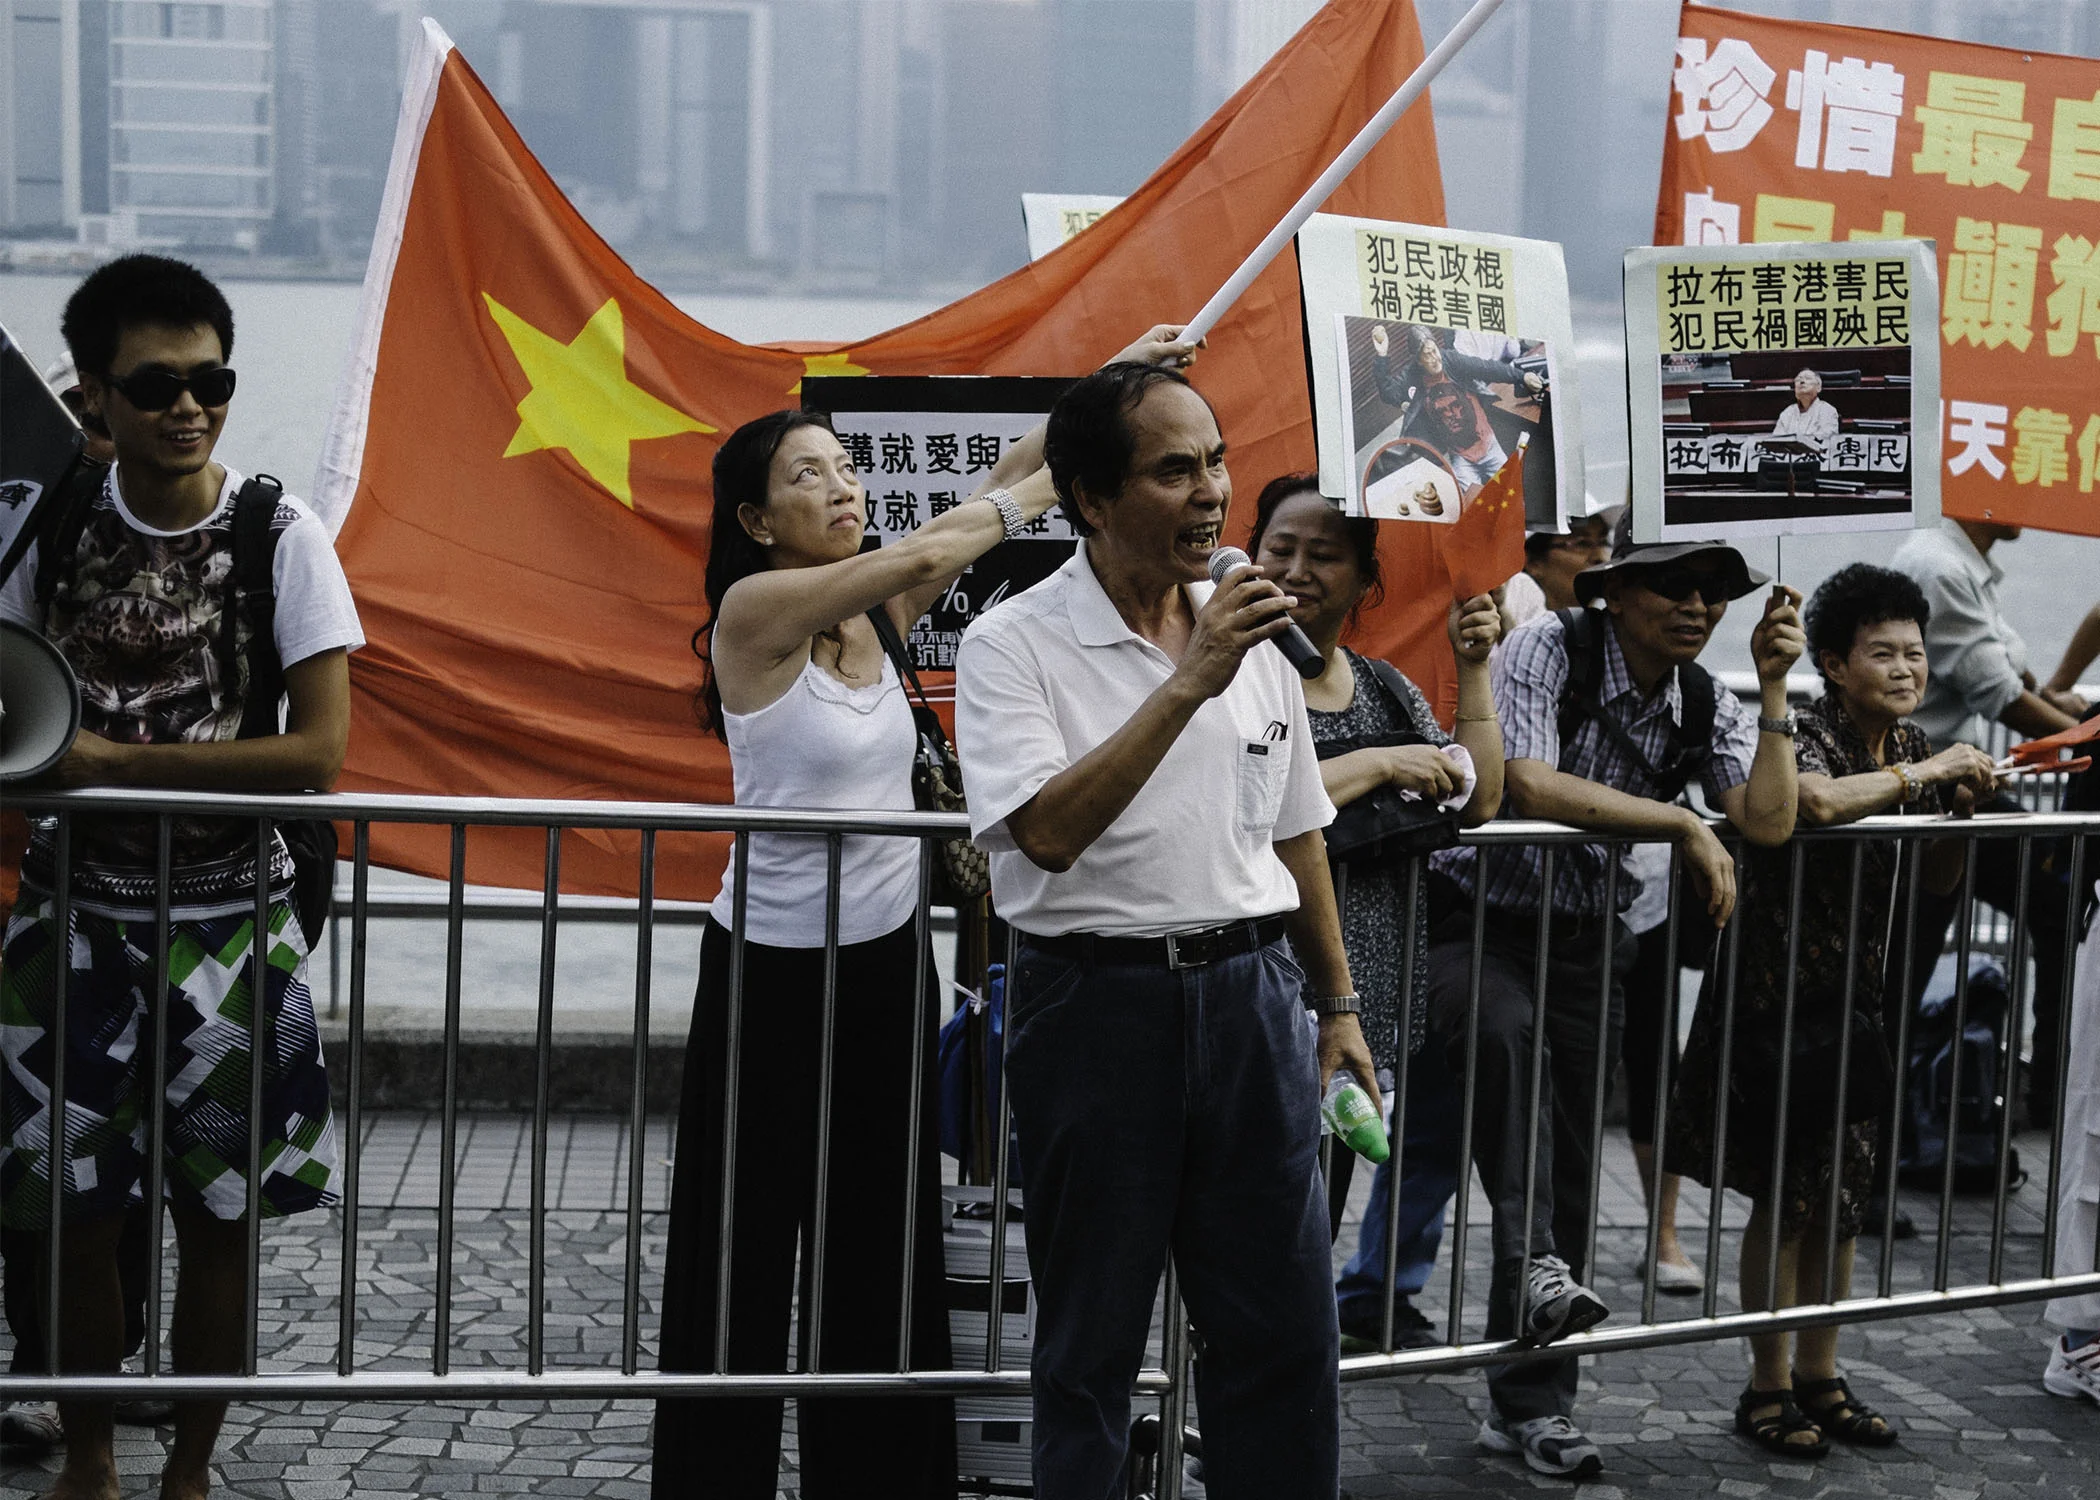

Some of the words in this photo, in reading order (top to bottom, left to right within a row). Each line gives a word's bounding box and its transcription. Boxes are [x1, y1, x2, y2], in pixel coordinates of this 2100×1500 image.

[1366, 233, 1504, 290] 犯民政棍
[1667, 260, 1909, 307] 拉布害港害民
[1369, 277, 1506, 334] 禍港害國
[1669, 305, 1909, 352] 犯民禍國殃民
